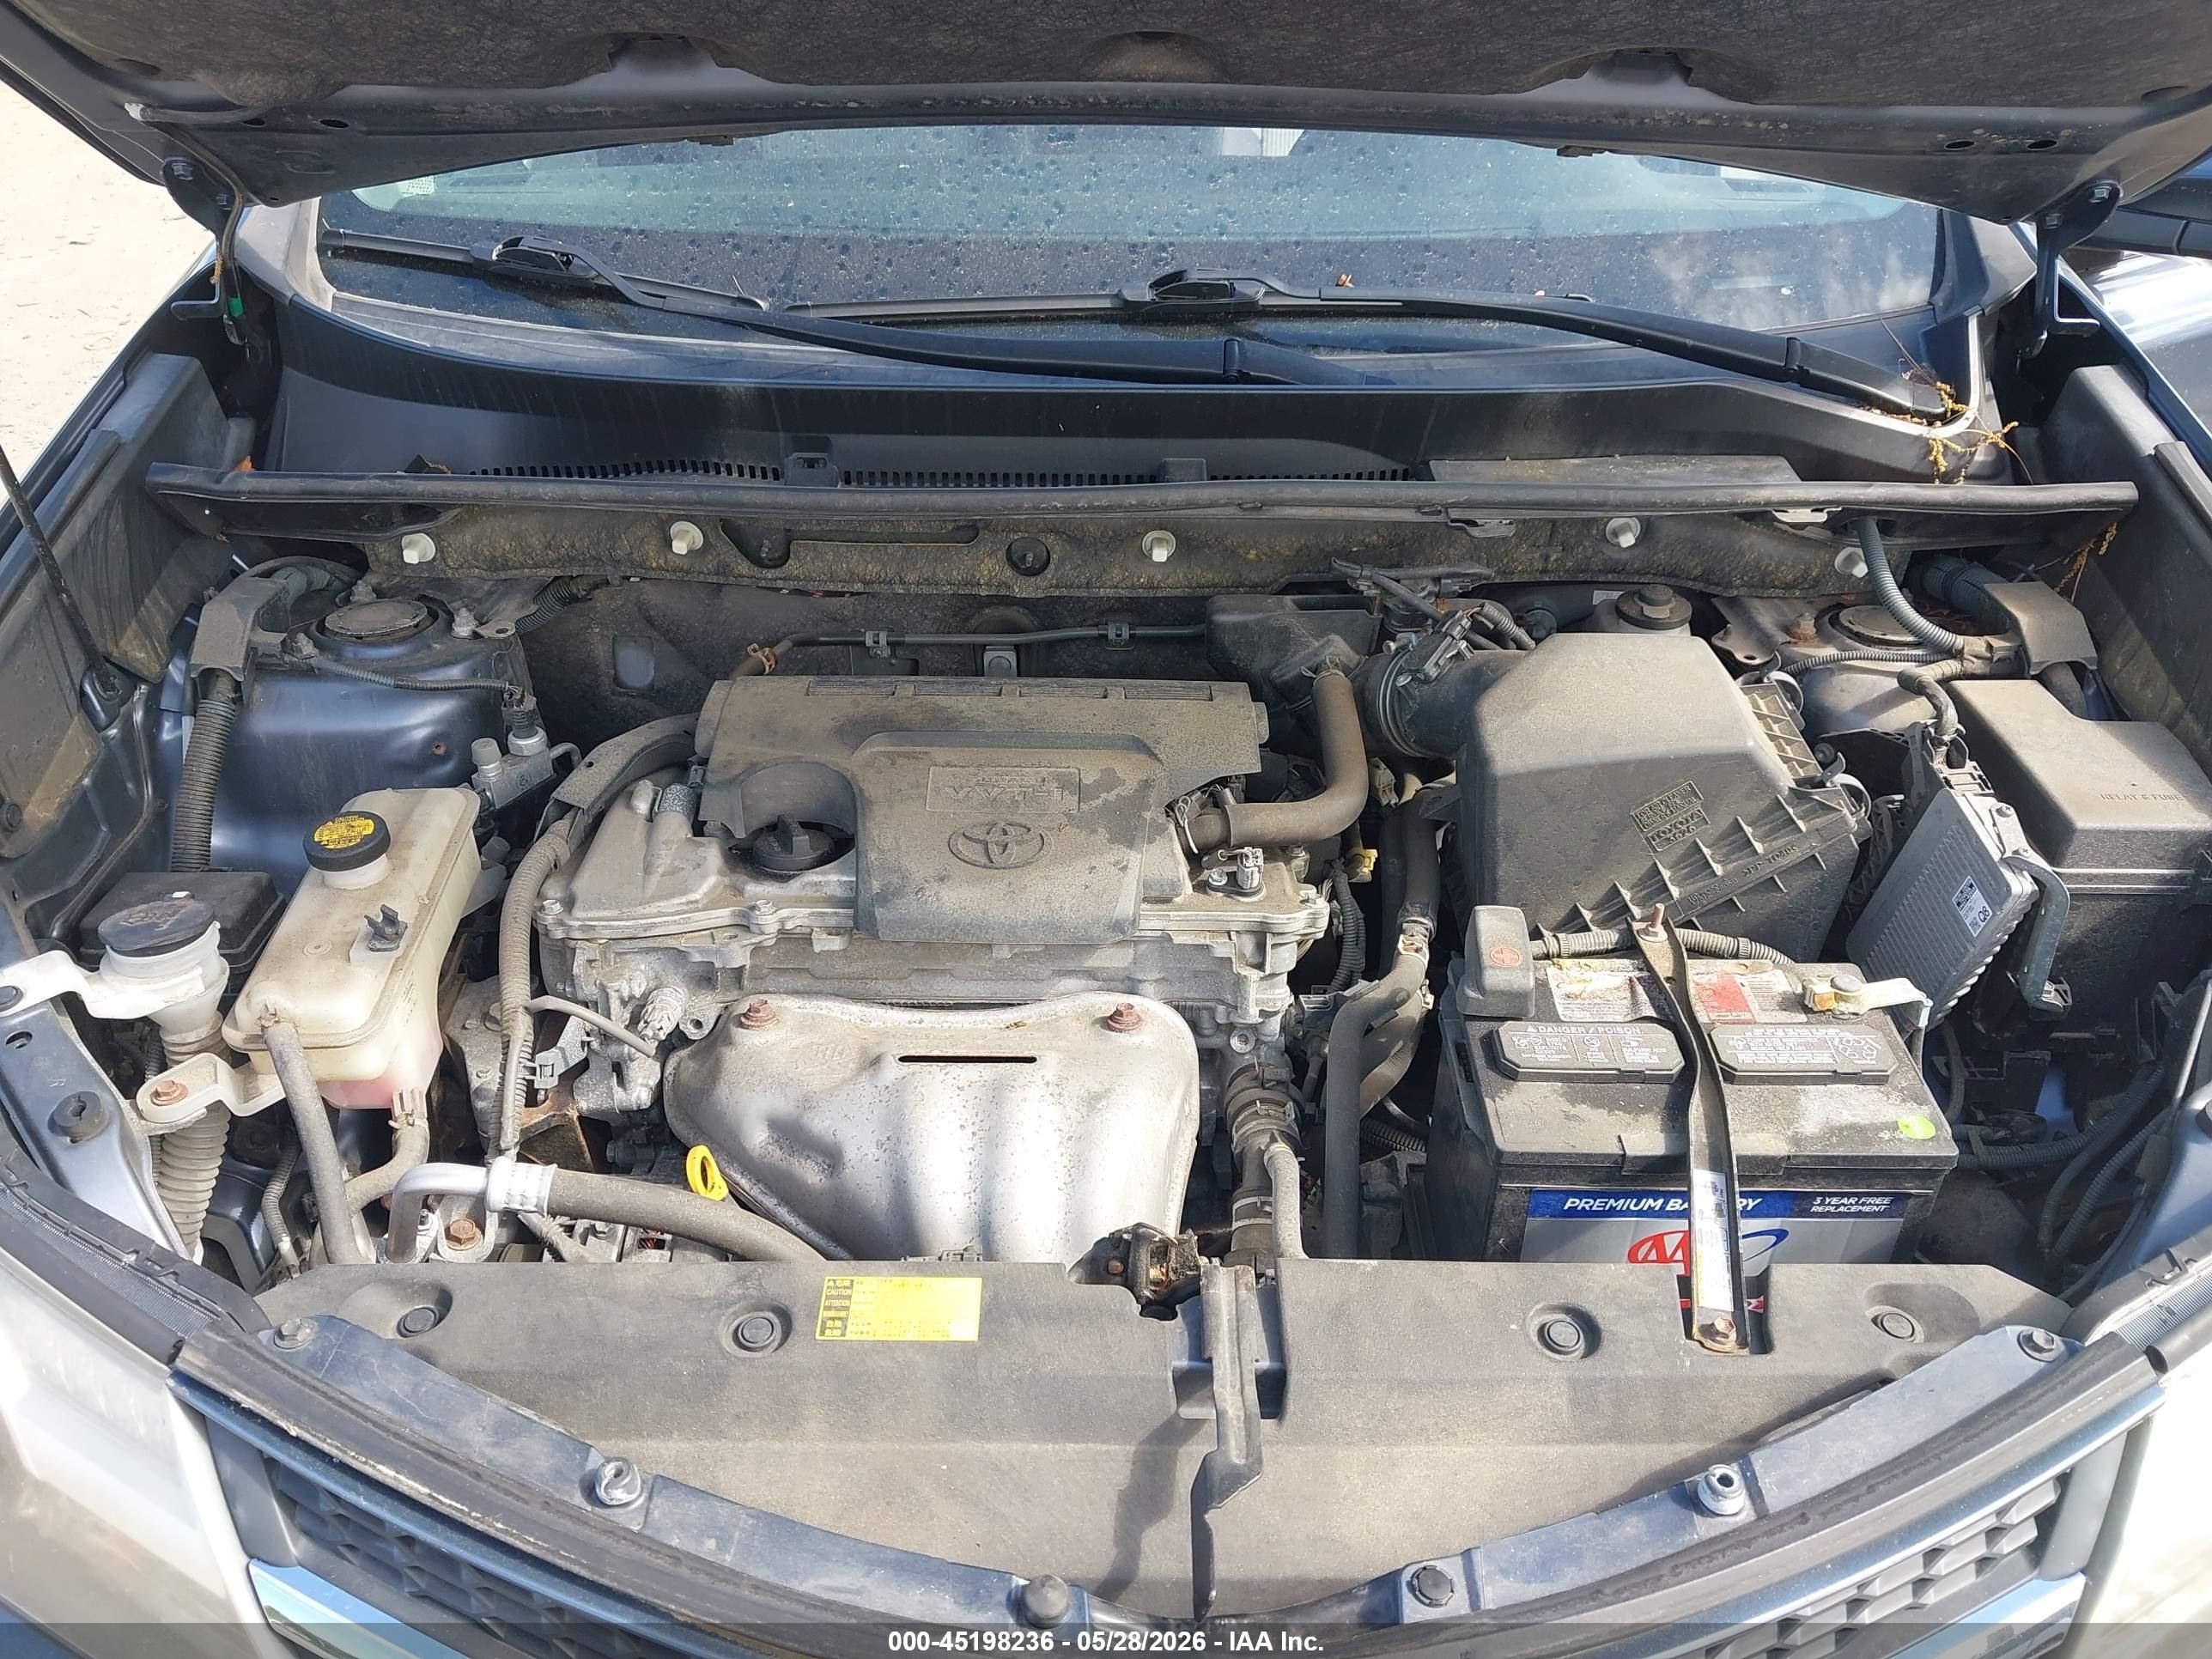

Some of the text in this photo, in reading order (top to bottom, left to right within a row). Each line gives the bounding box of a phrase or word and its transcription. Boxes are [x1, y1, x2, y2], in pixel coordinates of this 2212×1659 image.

[1650, 809, 1704, 842] TOYOTA
[1978, 906, 1990, 923] Q8
[1538, 1025, 1585, 1034] DANGER
[1563, 1198, 1664, 1210] PREMIUM
[1813, 1196, 1894, 1205] 3 YEAR FREE
